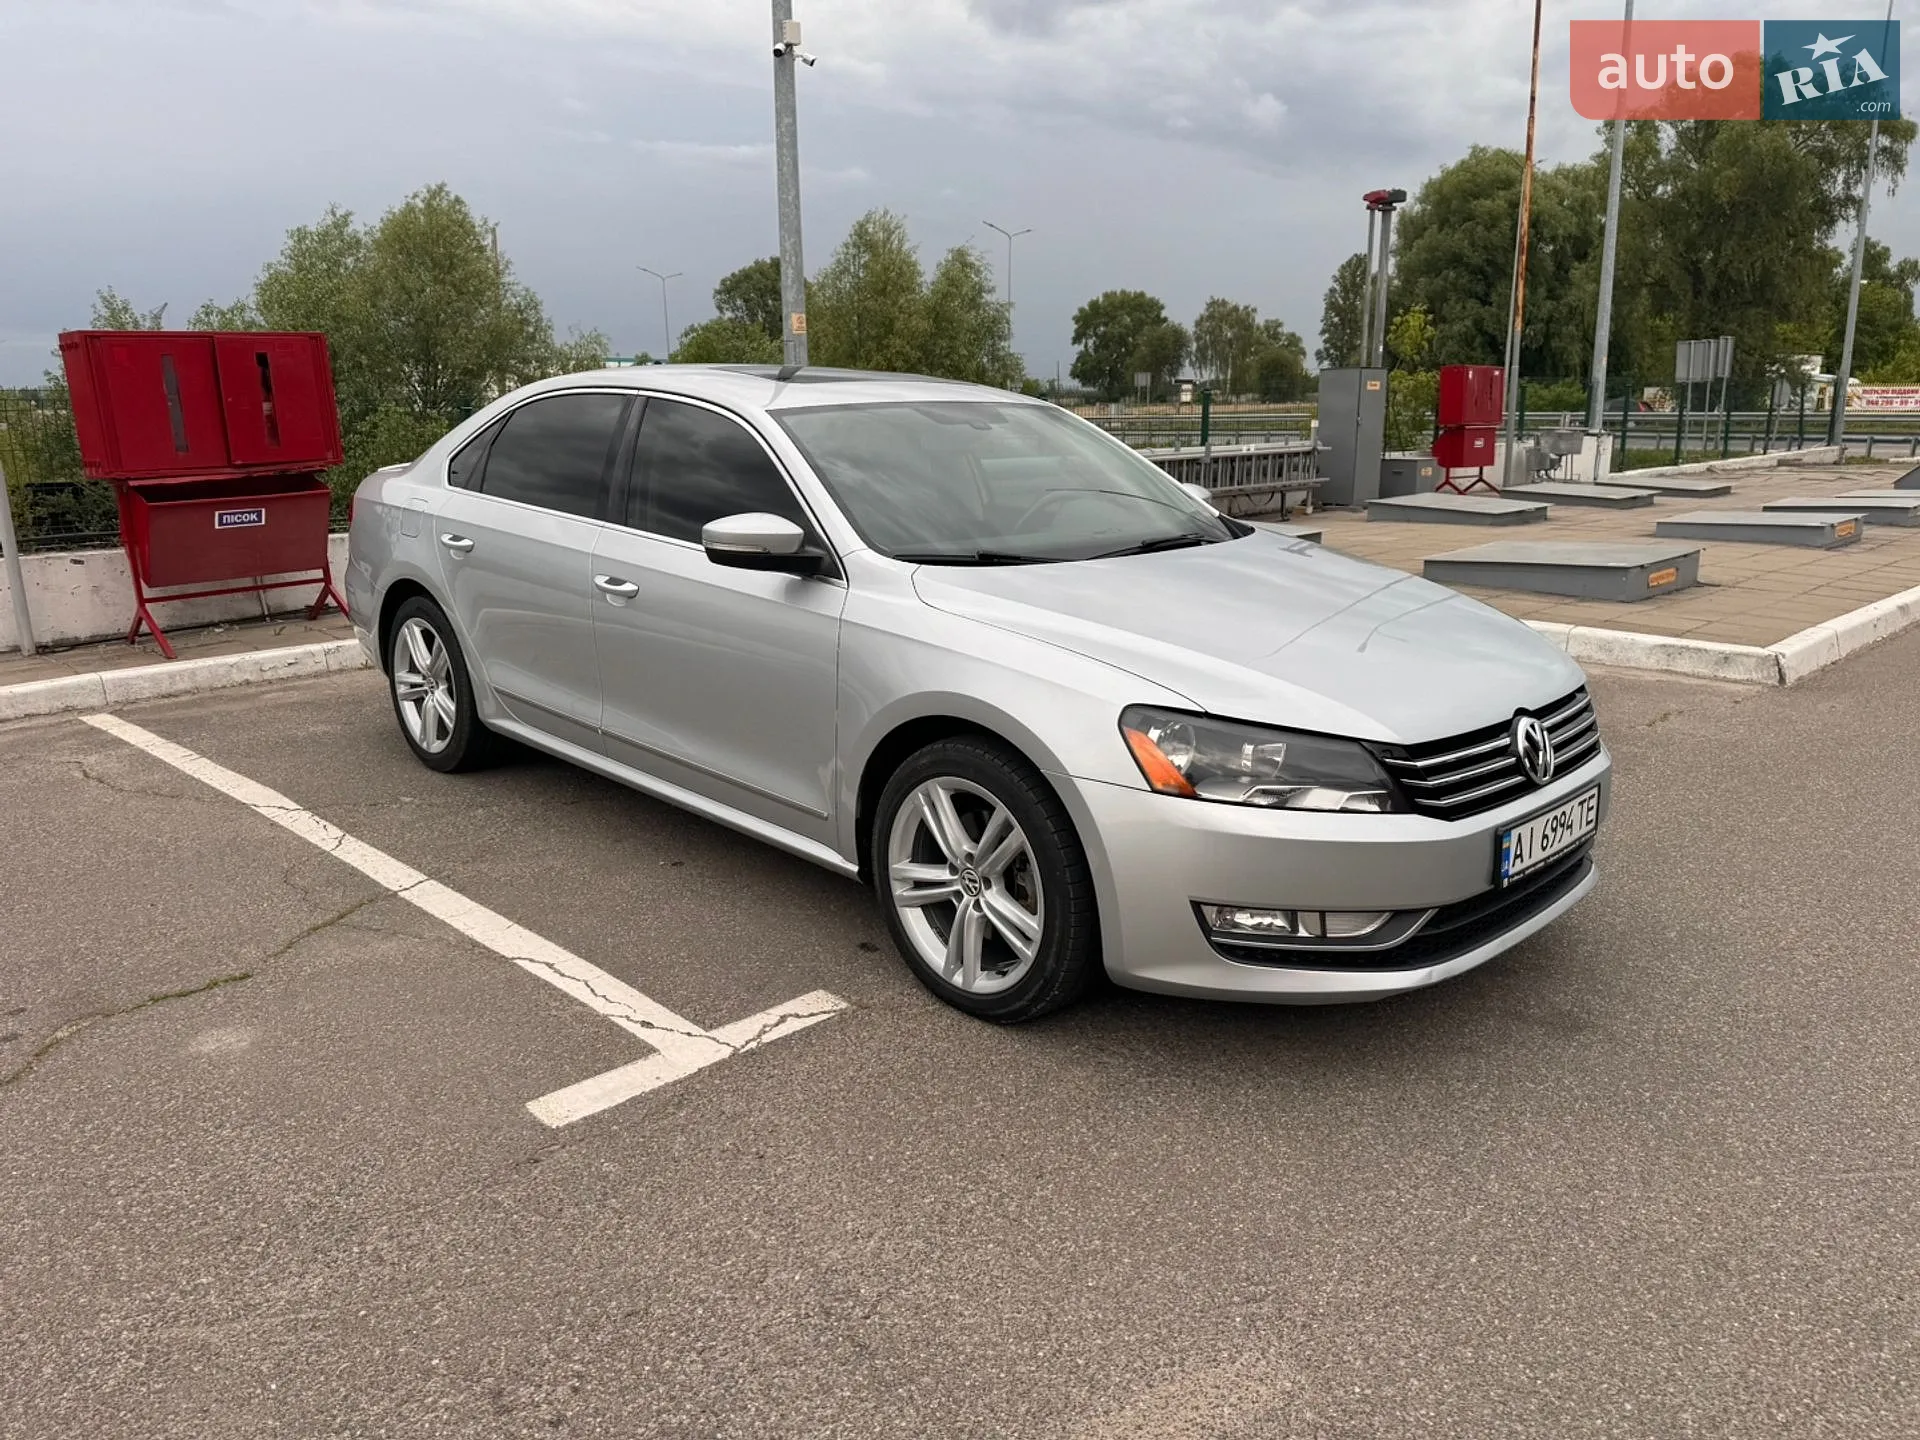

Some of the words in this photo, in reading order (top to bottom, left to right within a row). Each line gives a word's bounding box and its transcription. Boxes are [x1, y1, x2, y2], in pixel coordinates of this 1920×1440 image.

[222, 512, 258, 524] ПІСОК
[1512, 826, 1534, 867] AI
[1541, 805, 1574, 852] 6994
[1578, 793, 1596, 830] TE
